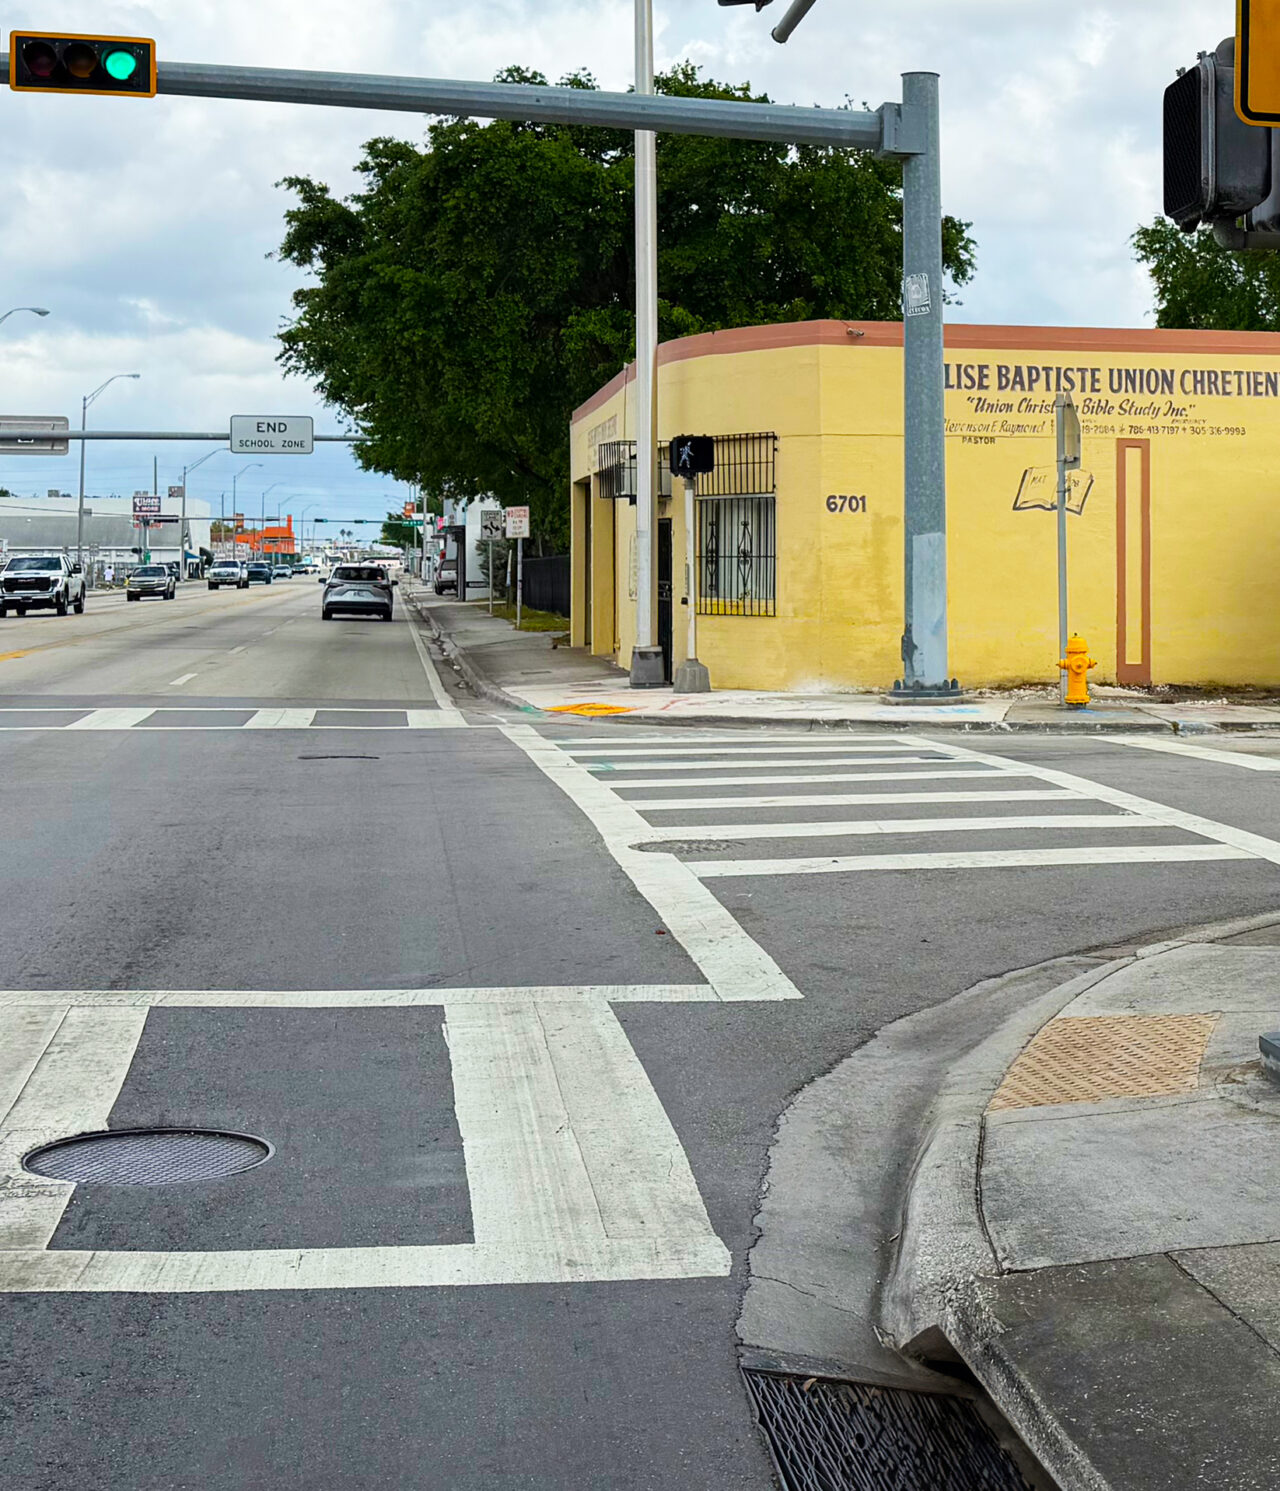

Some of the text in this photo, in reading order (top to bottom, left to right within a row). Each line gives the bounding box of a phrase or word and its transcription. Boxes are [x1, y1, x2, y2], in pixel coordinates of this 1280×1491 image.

[944, 363, 990, 391] LISE
[996, 364, 1101, 393] BAPTISTE
[1108, 368, 1175, 395] UNION
[1017, 397, 1079, 415] Christn
[1082, 398, 1115, 416] Bible
[1118, 399, 1161, 420] Study
[256, 422, 288, 434] END
[239, 439, 306, 449] SCHOOL ZONE
[962, 436, 996, 445] PASTOR
[826, 494, 867, 513] 6701
